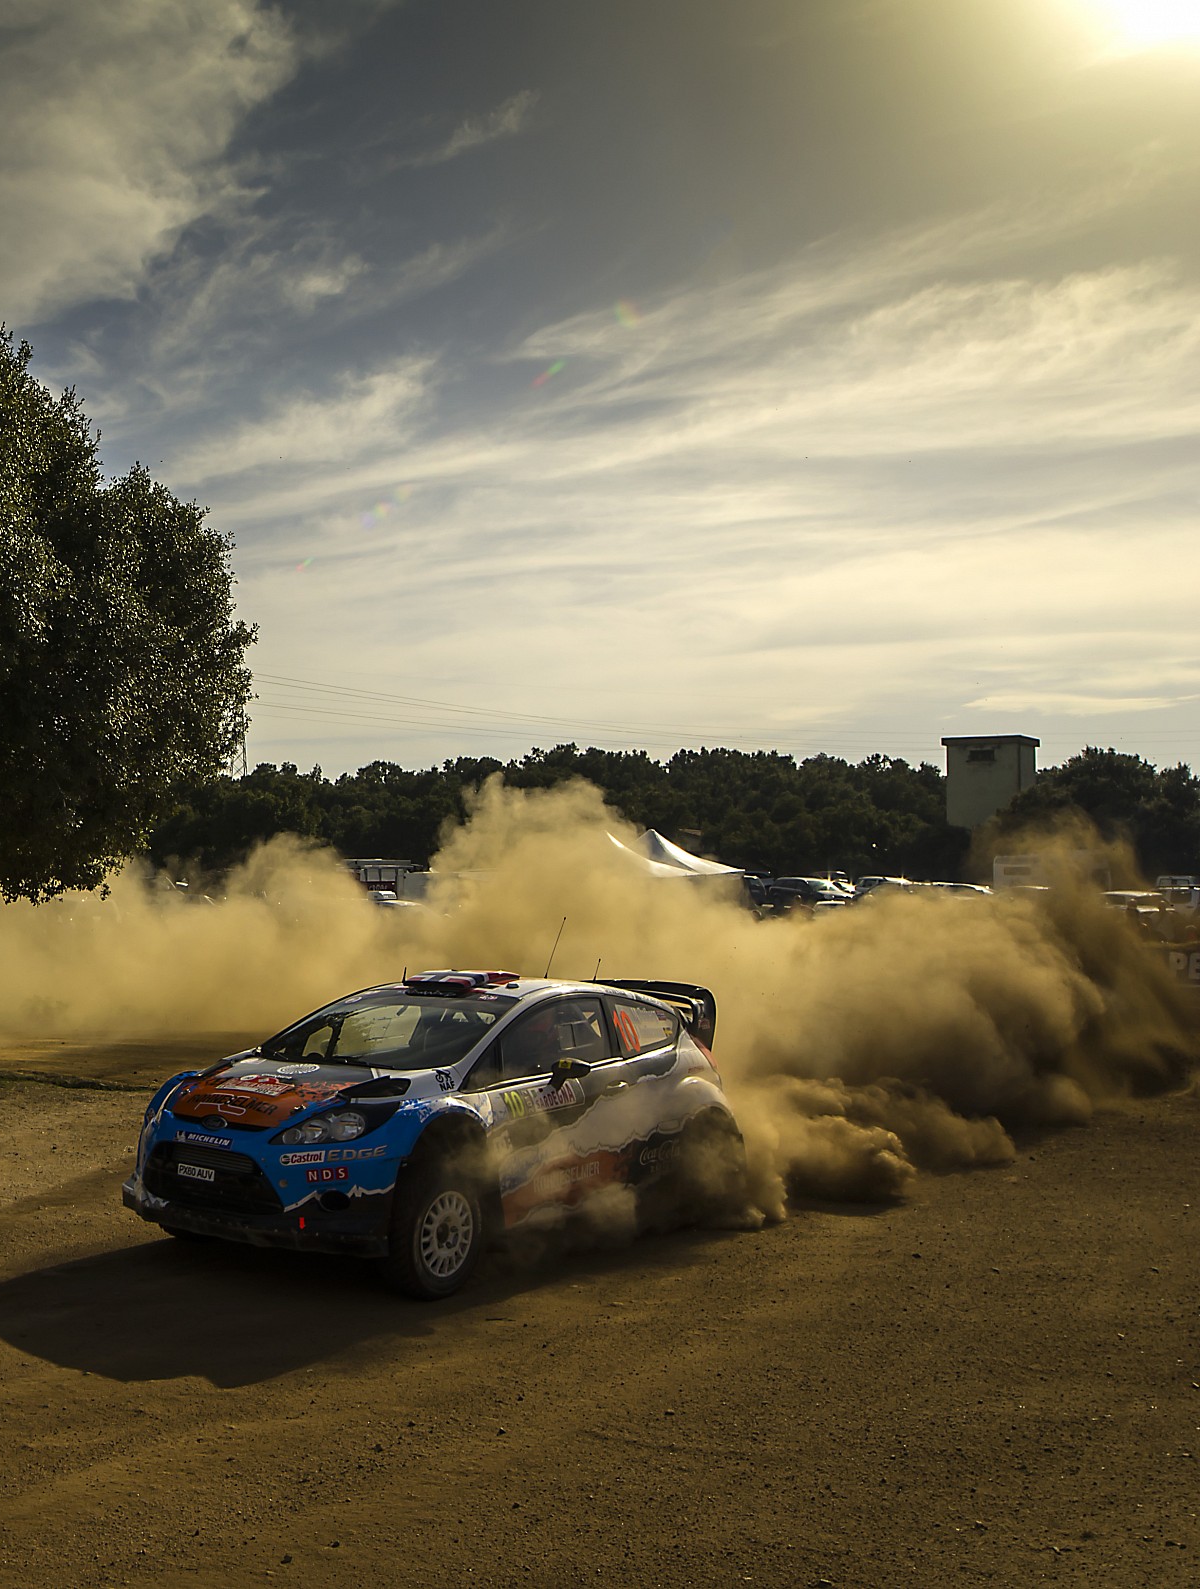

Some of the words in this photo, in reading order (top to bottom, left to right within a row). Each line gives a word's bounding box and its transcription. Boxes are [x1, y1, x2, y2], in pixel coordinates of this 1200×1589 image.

[612, 1009, 641, 1052] 10
[439, 1080, 455, 1091] NAF
[504, 1090, 524, 1118] 10
[535, 1083, 575, 1109] SARDEGNA
[187, 1132, 231, 1146] MICHELIN
[290, 1152, 322, 1164] Castrol
[327, 1144, 388, 1162] EDGE
[179, 1164, 197, 1177] PX60
[196, 1168, 214, 1180] AUV
